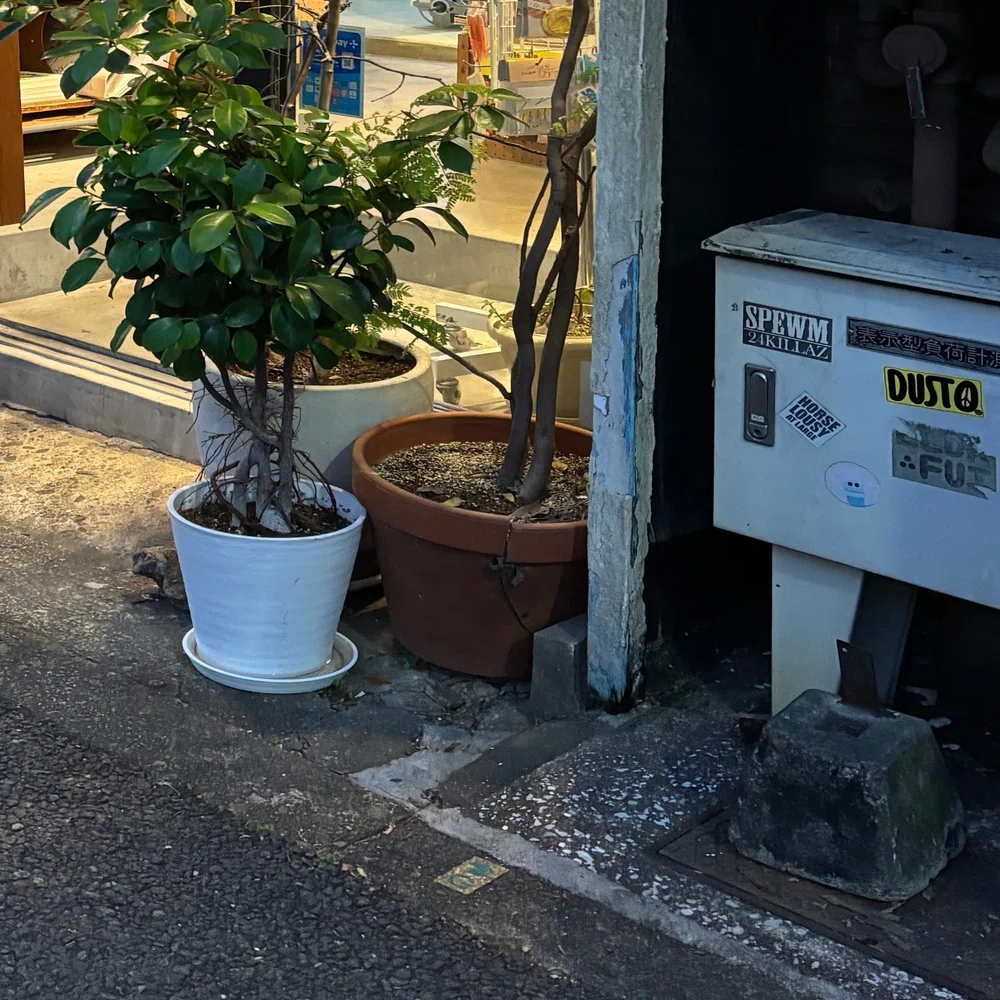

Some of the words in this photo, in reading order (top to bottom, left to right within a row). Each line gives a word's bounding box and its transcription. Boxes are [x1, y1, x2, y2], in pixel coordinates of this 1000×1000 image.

[745, 303, 829, 345] SPEWM
[748, 331, 829, 361] 24KILLAZ
[785, 413, 797, 425] AT
[794, 420, 818, 442] LARGE
[788, 404, 831, 438] LOUSY
[798, 395, 841, 433] HORSE
